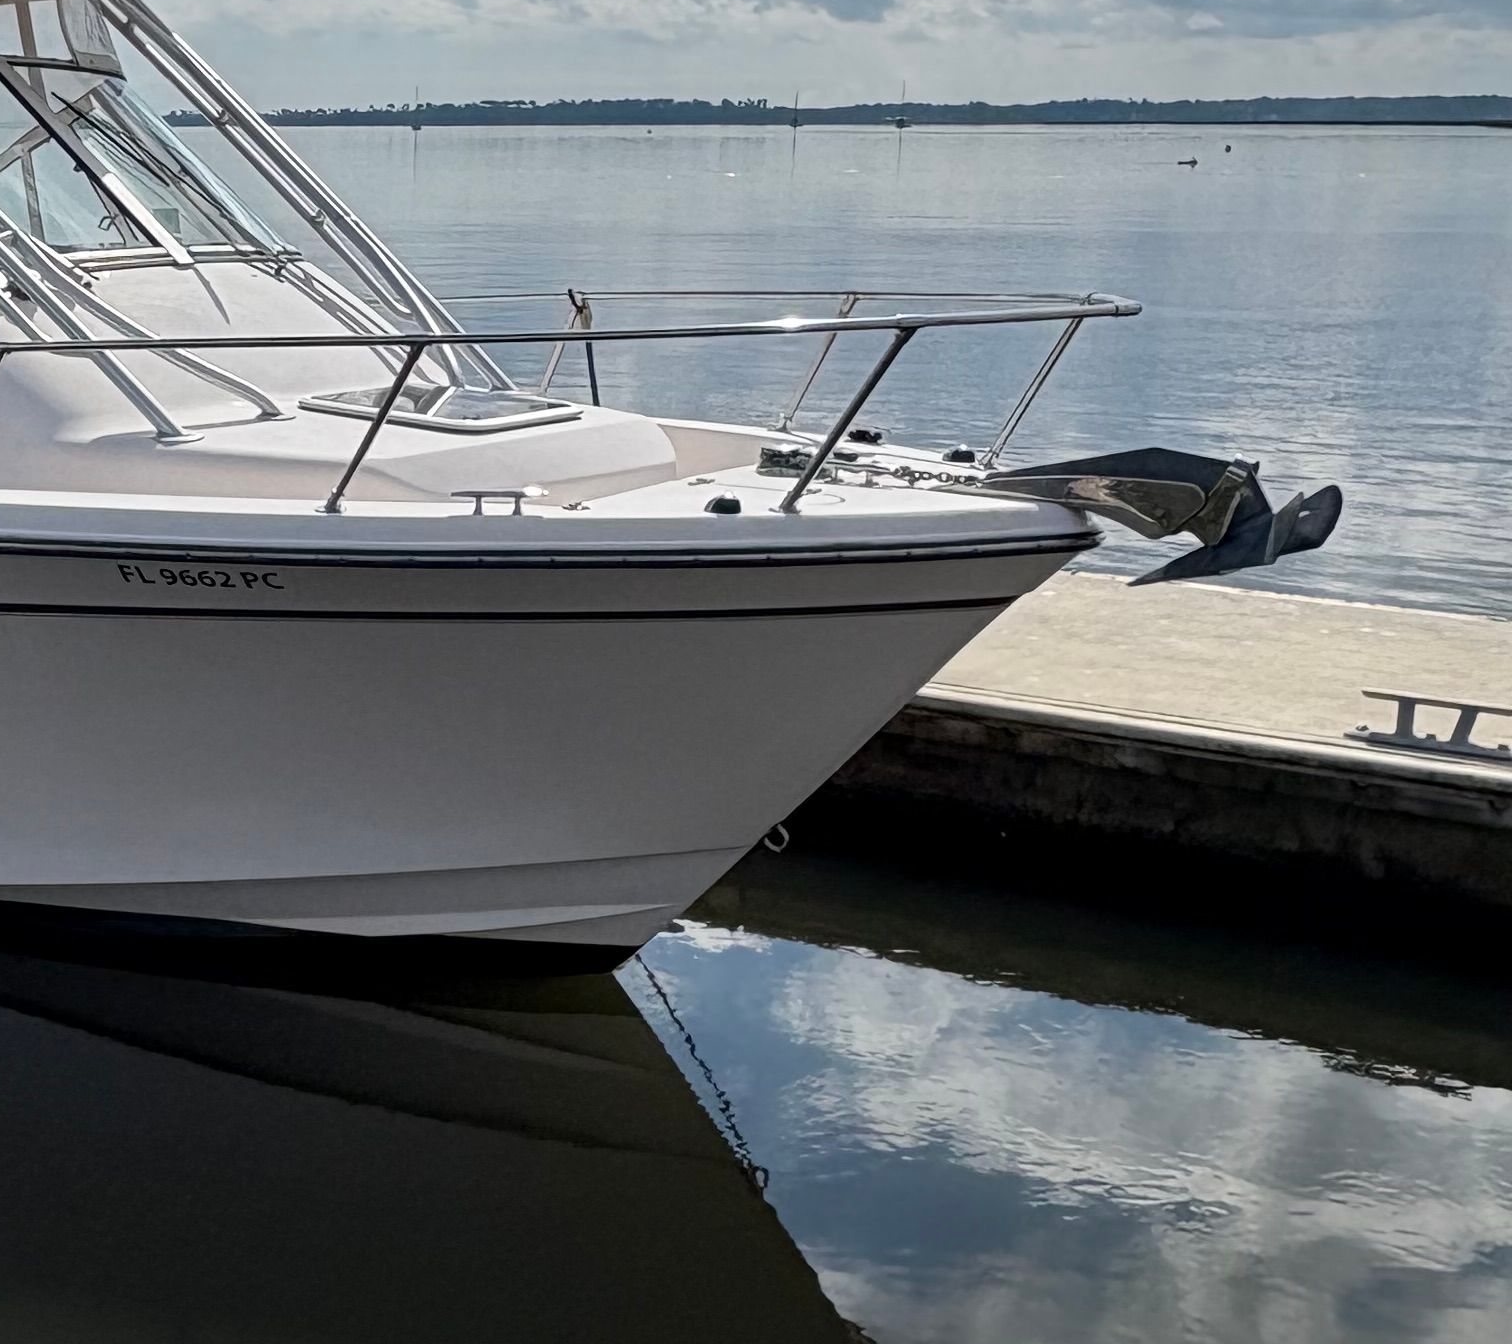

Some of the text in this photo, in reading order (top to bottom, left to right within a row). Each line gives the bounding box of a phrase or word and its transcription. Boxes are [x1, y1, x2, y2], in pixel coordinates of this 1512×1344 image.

[117, 564, 285, 589] FL 9662 PC
